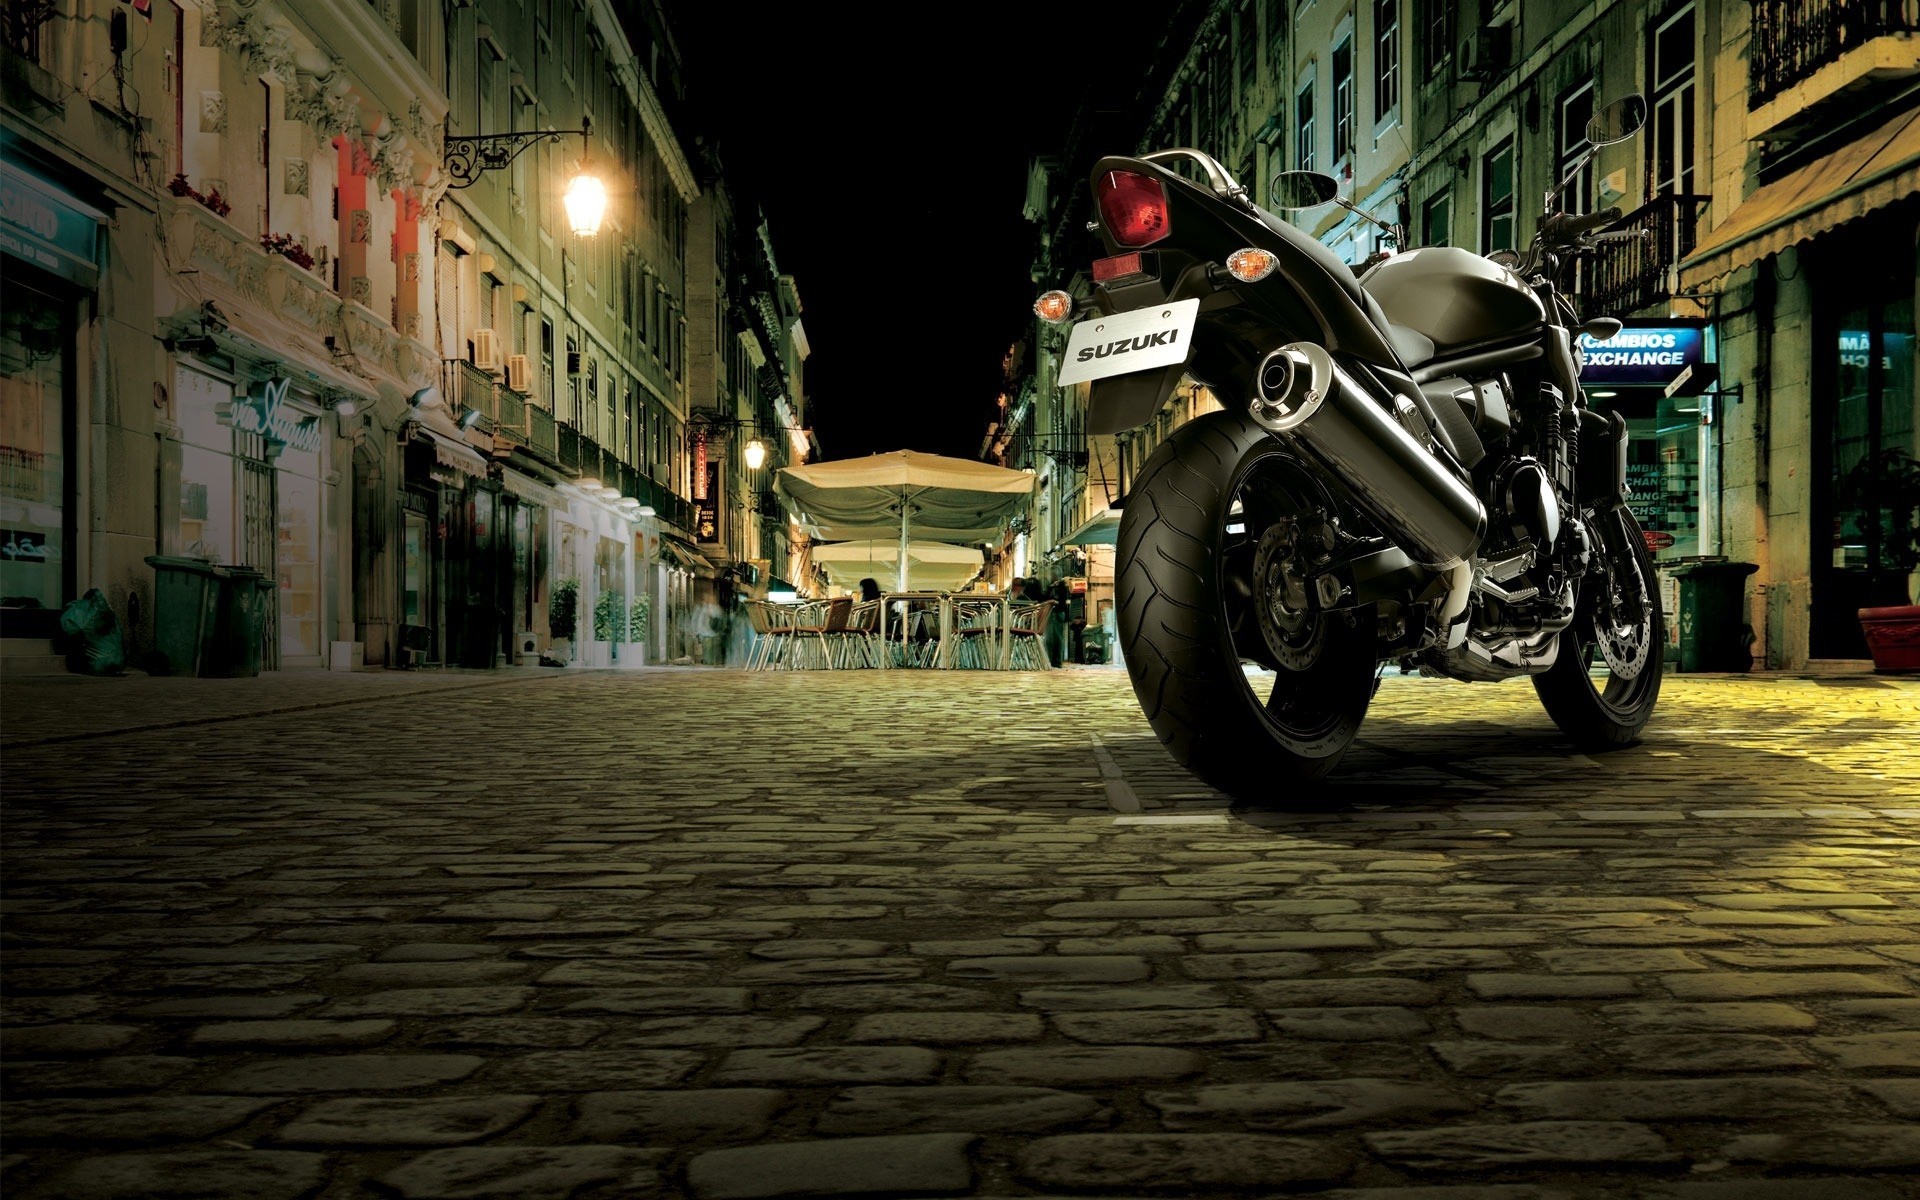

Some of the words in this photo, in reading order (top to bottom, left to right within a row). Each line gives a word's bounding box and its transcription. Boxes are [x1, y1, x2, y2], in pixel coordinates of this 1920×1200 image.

[1077, 328, 1178, 362] SUZUKI
[1582, 351, 1685, 366] EXCHANGE
[1625, 463, 1670, 473] AMBIOS
[1627, 491, 1670, 501] HANGE
